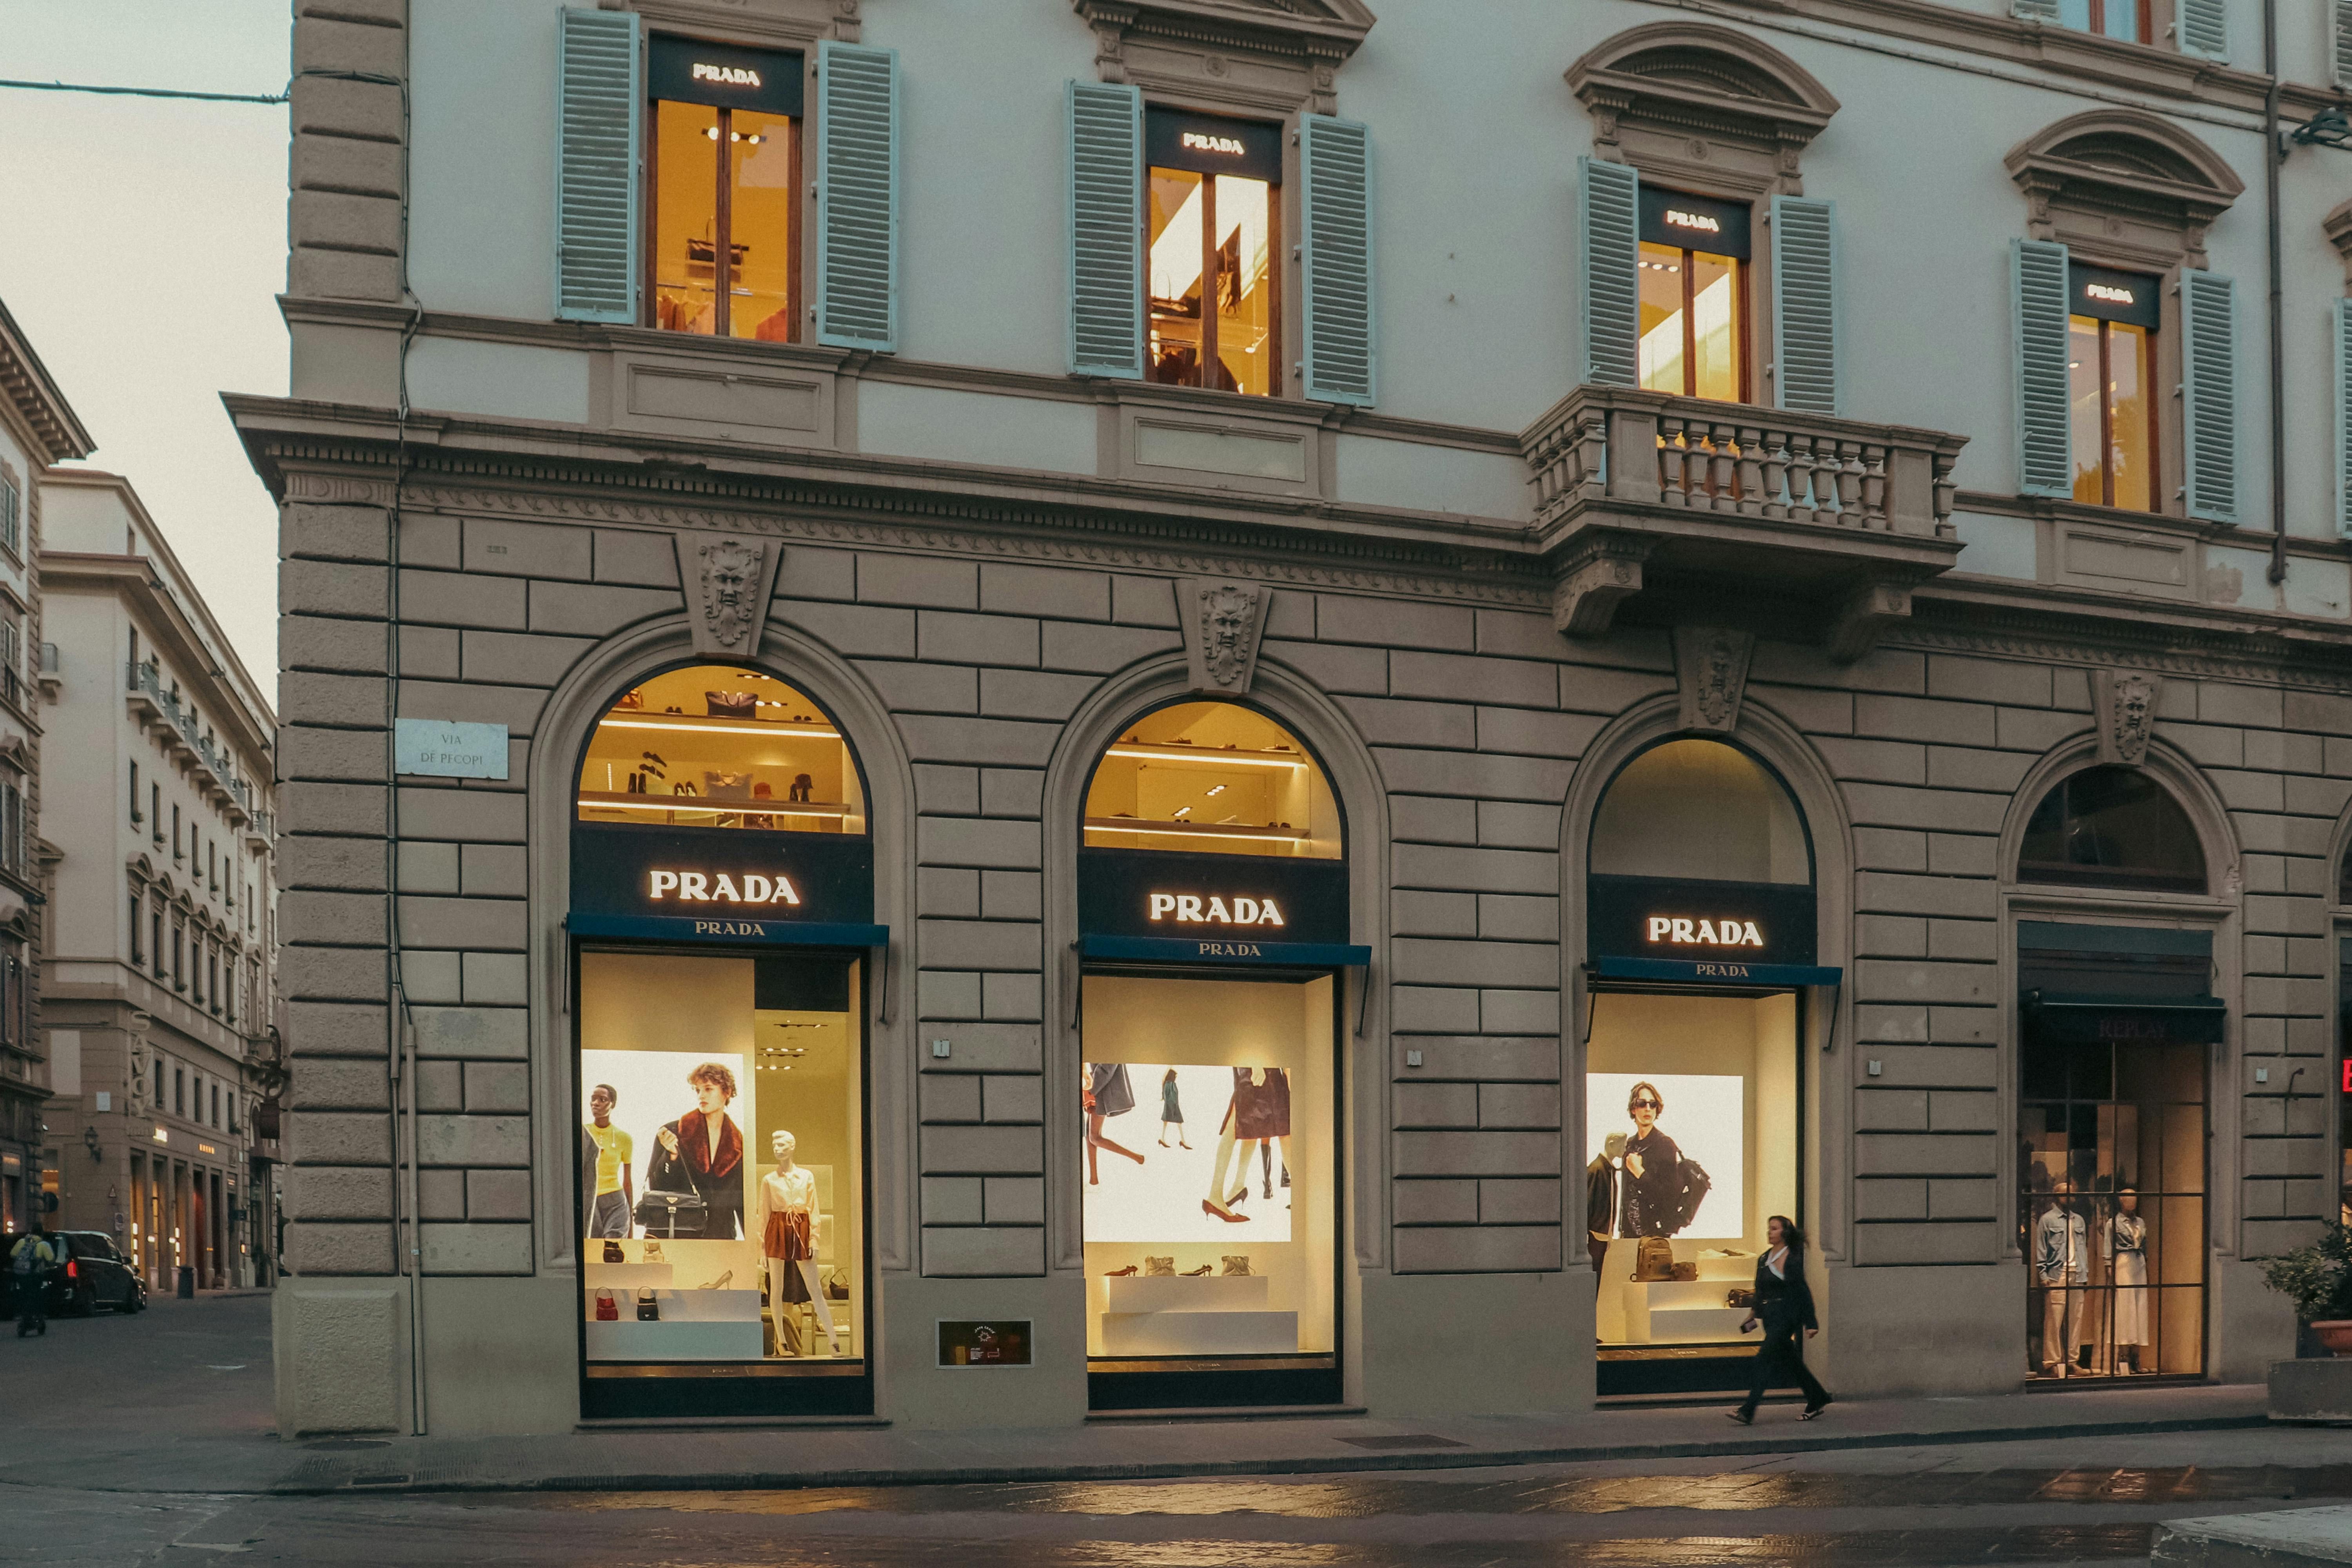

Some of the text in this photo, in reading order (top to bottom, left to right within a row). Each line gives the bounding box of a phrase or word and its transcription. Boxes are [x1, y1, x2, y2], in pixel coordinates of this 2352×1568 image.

[693, 63, 760, 87] PRADA
[1183, 132, 1245, 155] PRADA
[1667, 210, 1719, 232] PRADA
[2087, 284, 2134, 304] PRADA
[441, 734, 461, 744] VIA
[650, 870, 800, 905] PRADA
[1150, 894, 1284, 925] PRADA
[695, 921, 765, 936] PRADA
[1649, 917, 1763, 946] PRADA
[1199, 943, 1261, 956] PRADA
[1696, 964, 1749, 977] PRADA
[131, 1011, 151, 1118] SAVOY
